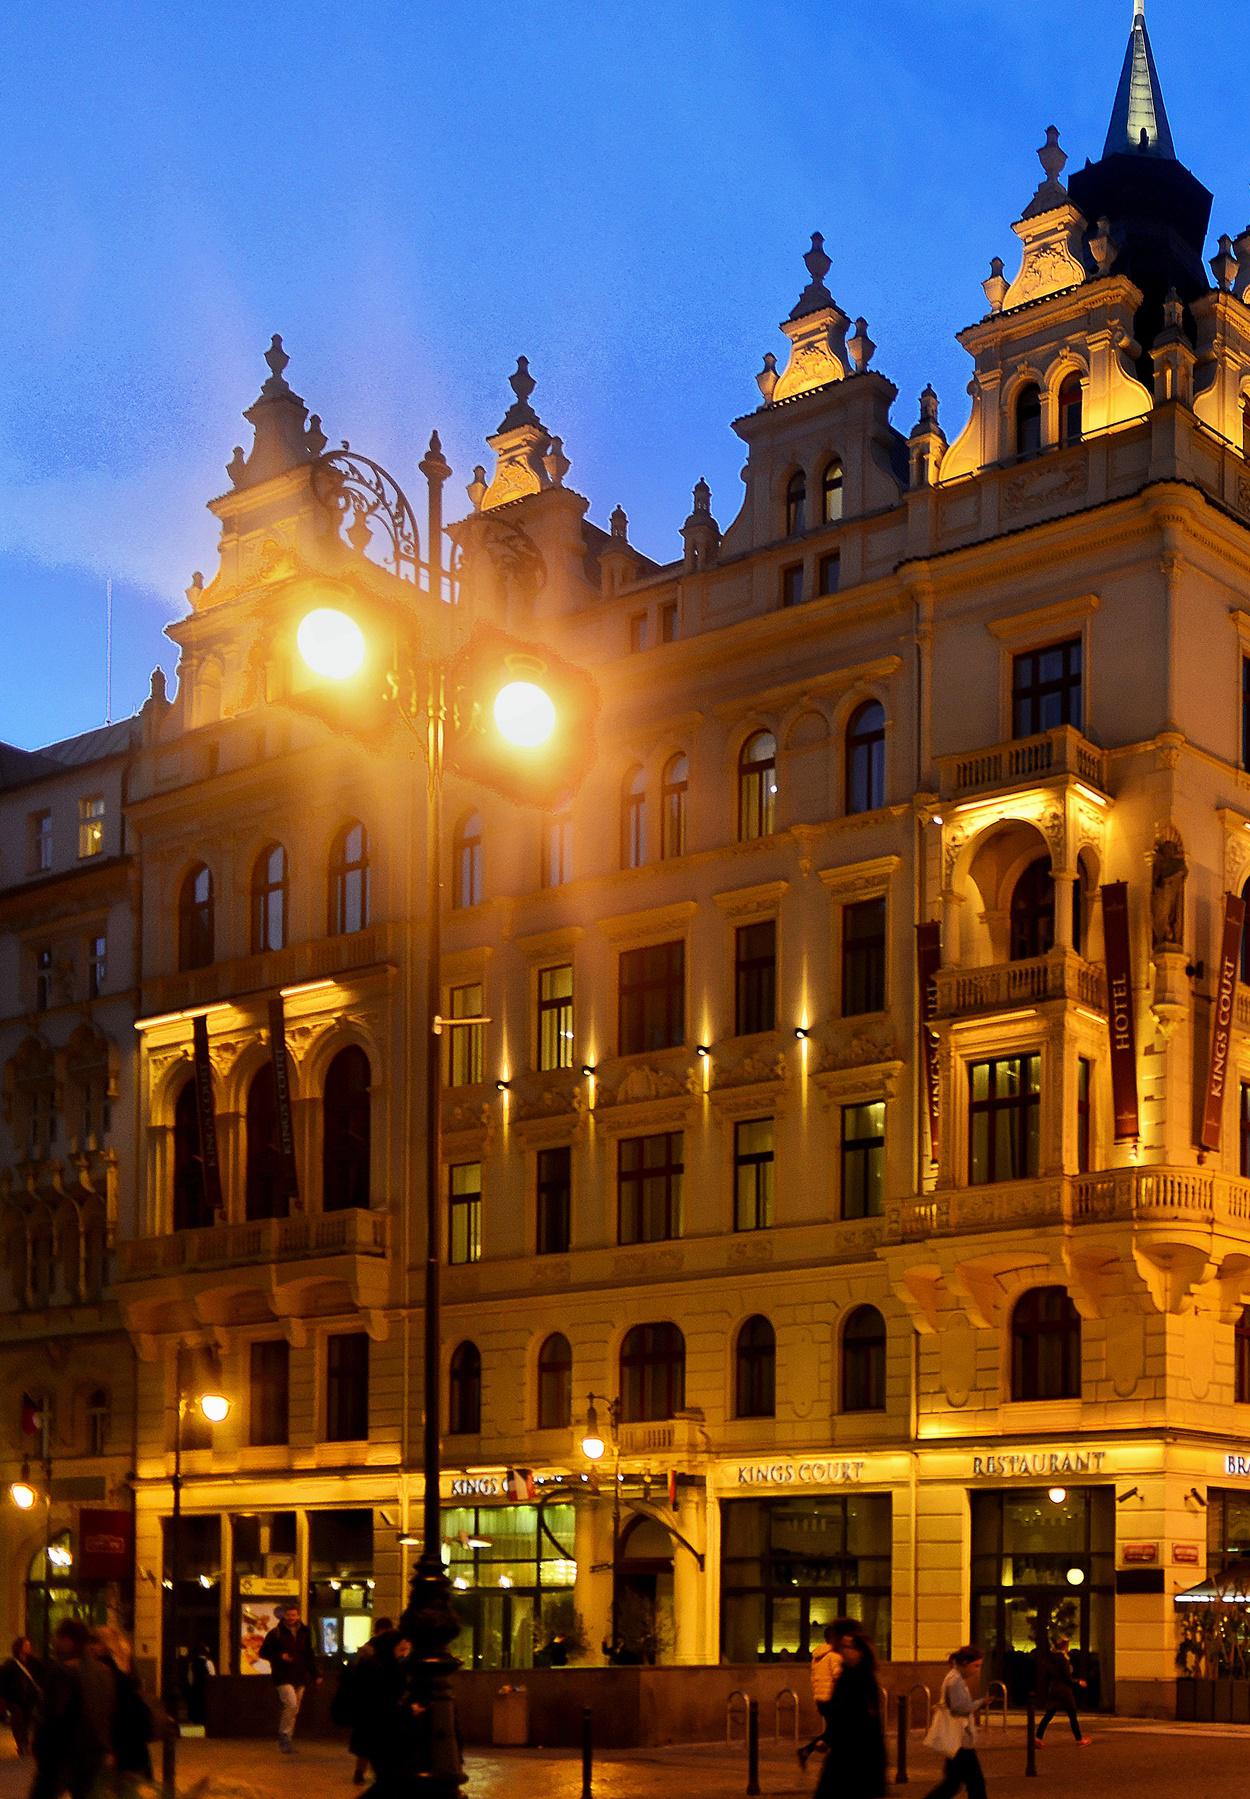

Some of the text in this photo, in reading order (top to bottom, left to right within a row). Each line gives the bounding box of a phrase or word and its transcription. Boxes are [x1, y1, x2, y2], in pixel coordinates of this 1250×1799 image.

[1112, 973, 1130, 1050] HOTEL
[1211, 956, 1236, 1098] KINGS COURT
[737, 1461, 865, 1484] KINGS COURT
[973, 1451, 1105, 1476] RESTAURANT
[451, 1477, 498, 1496] KINGS
